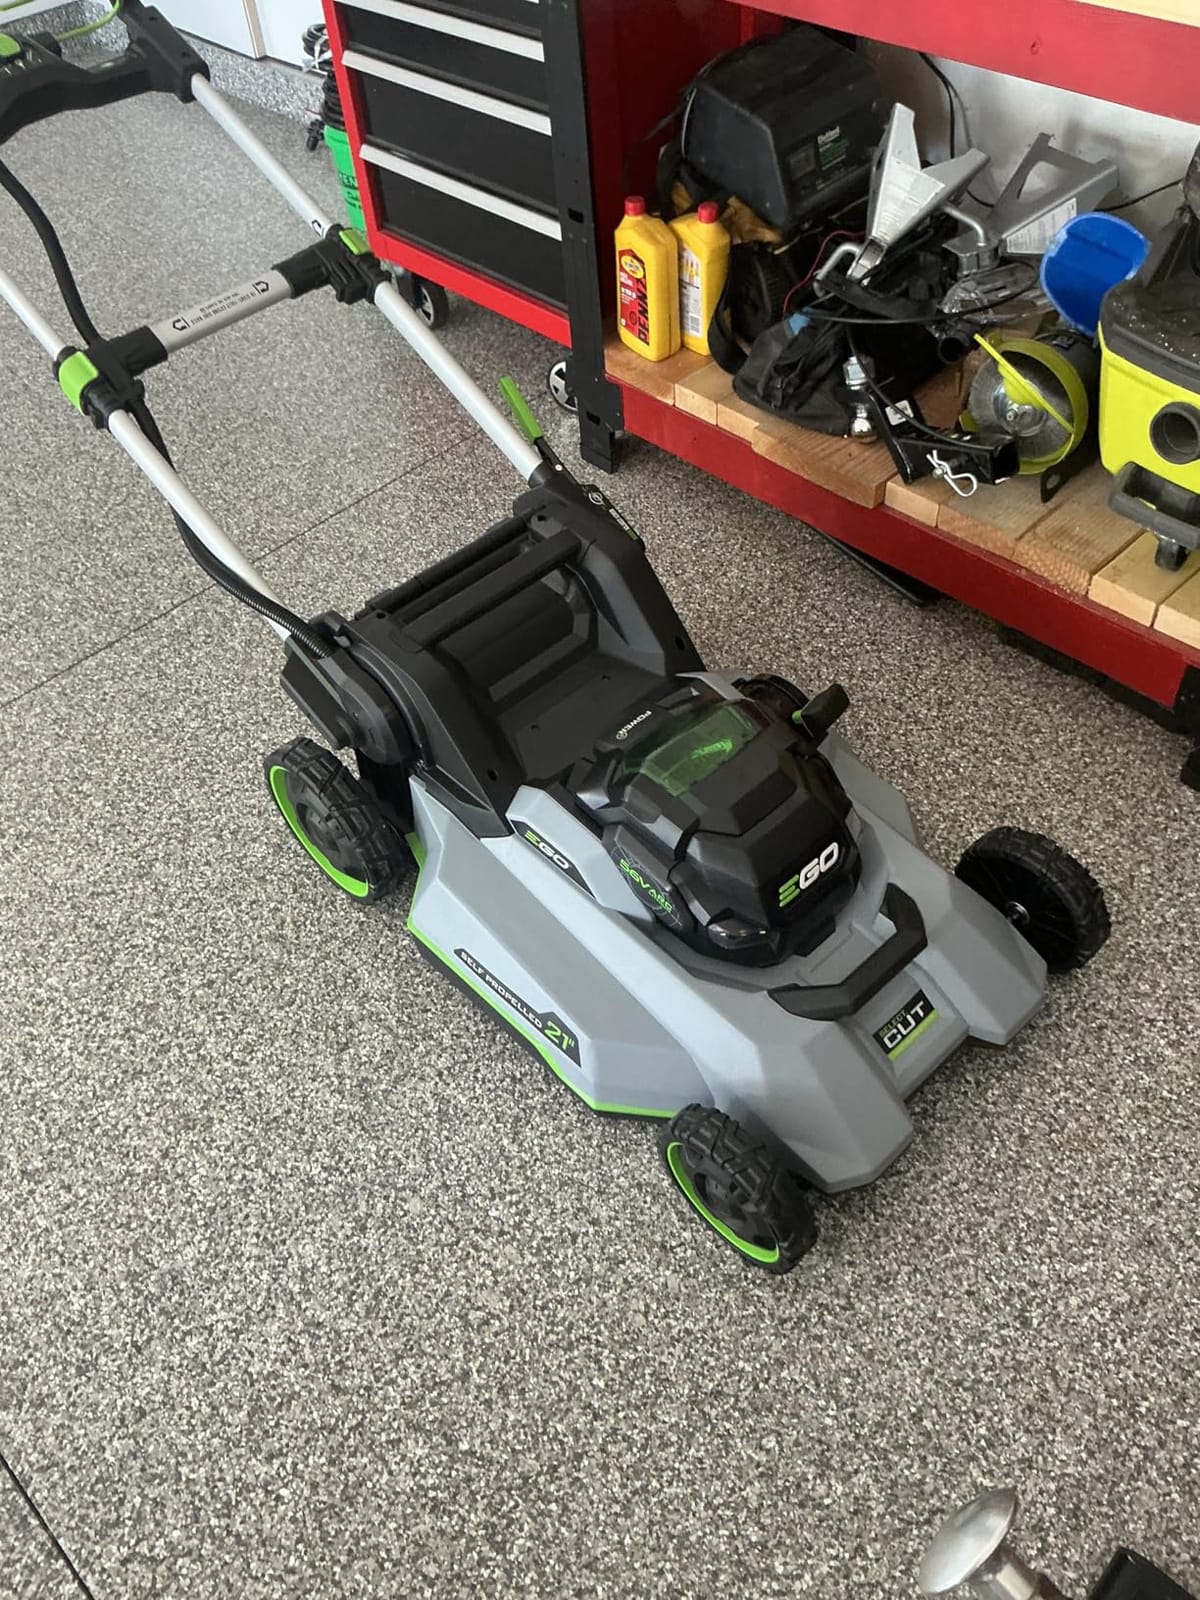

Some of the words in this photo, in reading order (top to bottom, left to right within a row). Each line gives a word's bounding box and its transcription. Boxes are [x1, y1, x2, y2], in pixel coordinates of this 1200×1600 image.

[524, 830, 570, 870] EGO
[618, 858, 650, 889] 56V
[778, 841, 839, 908] EGO
[460, 951, 485, 974] SELF
[485, 974, 543, 1028] PROPELLED
[883, 1000, 924, 1049] CUT
